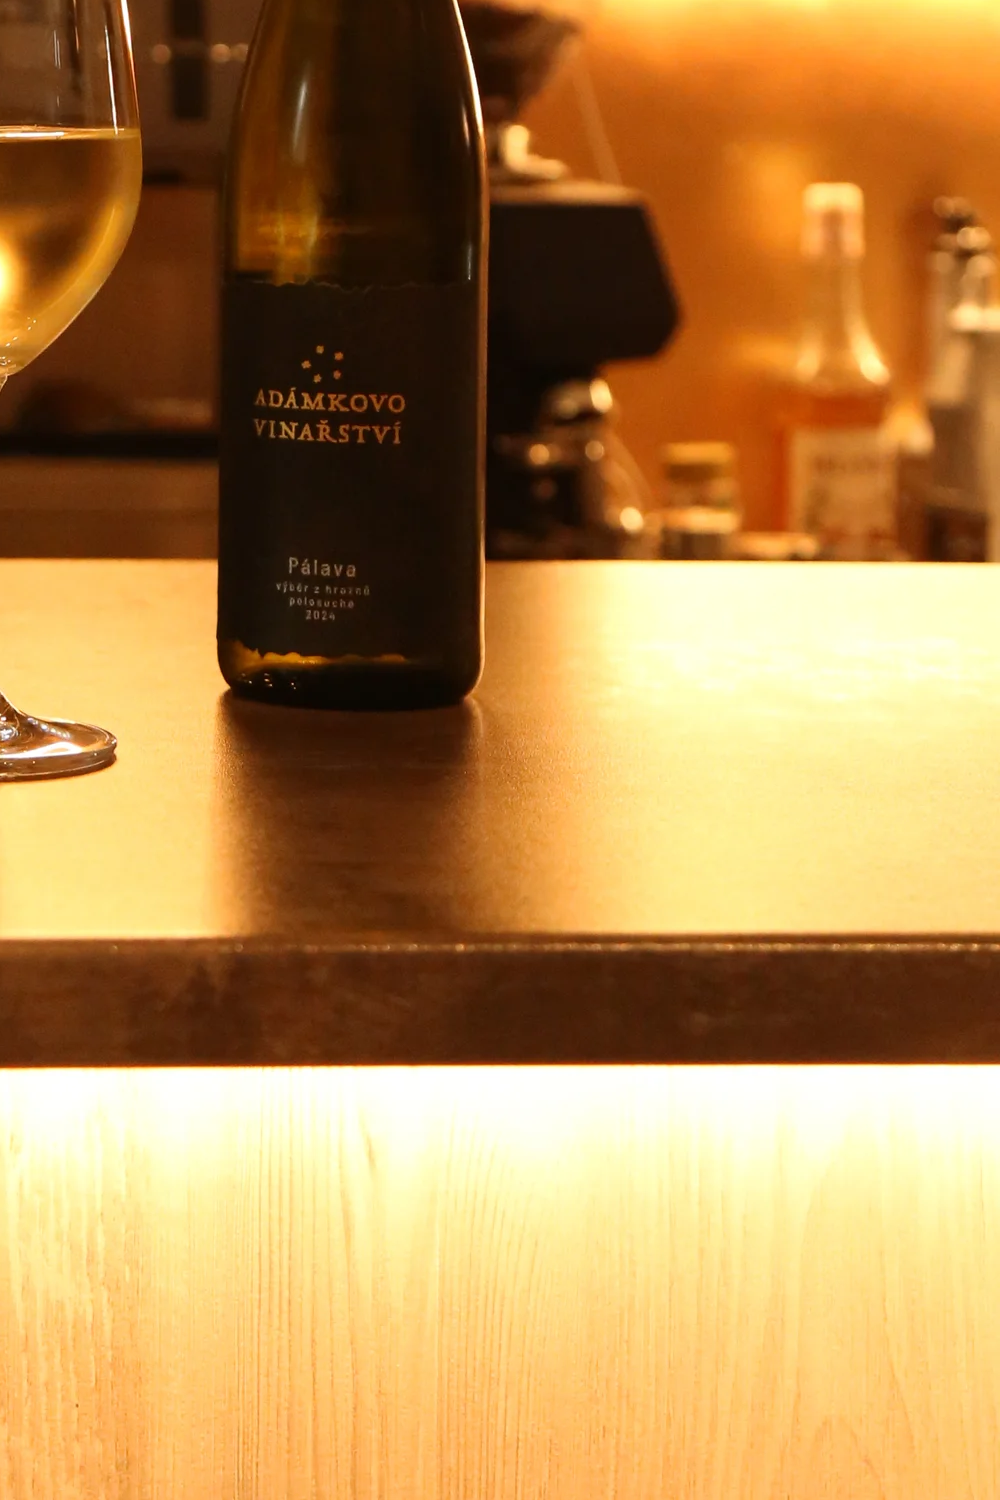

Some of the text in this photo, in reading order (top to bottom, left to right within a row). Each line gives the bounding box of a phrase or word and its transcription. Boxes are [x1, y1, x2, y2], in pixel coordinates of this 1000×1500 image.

[254, 387, 406, 414] ADÁMKOVO
[253, 418, 401, 445] VINAŘSTVÍ
[288, 557, 357, 578] Pálava
[313, 585, 321, 594] z
[305, 609, 336, 621] 2024
